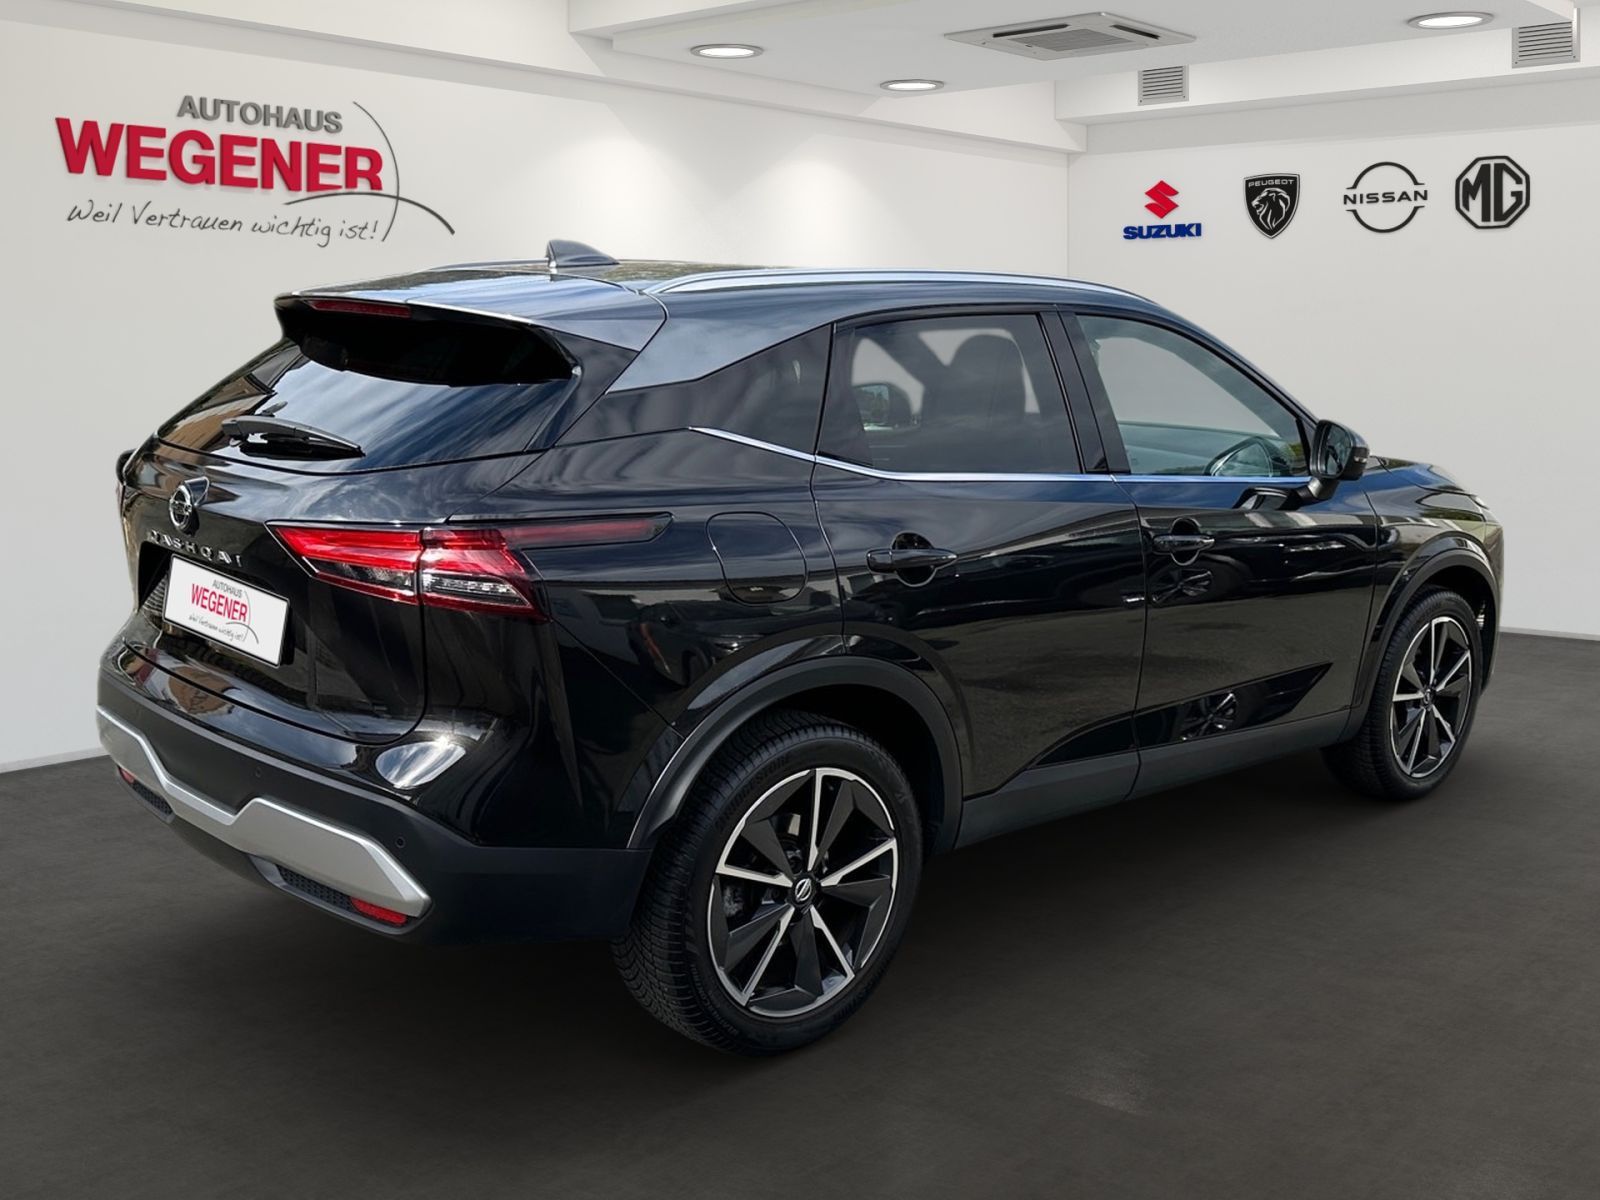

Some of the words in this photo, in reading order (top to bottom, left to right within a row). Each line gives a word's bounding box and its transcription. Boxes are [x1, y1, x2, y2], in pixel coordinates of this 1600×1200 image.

[176, 95, 343, 134] AUTOHAUS
[55, 117, 384, 193] WEGENER
[1247, 178, 1295, 189] PEUGEOT
[1342, 189, 1429, 206] NISSAN
[1461, 161, 1524, 224] MG
[67, 199, 123, 224] Weil
[131, 200, 243, 233] Vertrauen
[250, 208, 333, 249] wichtig
[338, 219, 380, 242] ist!
[1122, 222, 1202, 240] SUZUKI
[191, 583, 249, 623] WEGENER
[211, 579, 243, 599] AUTOHAUS
